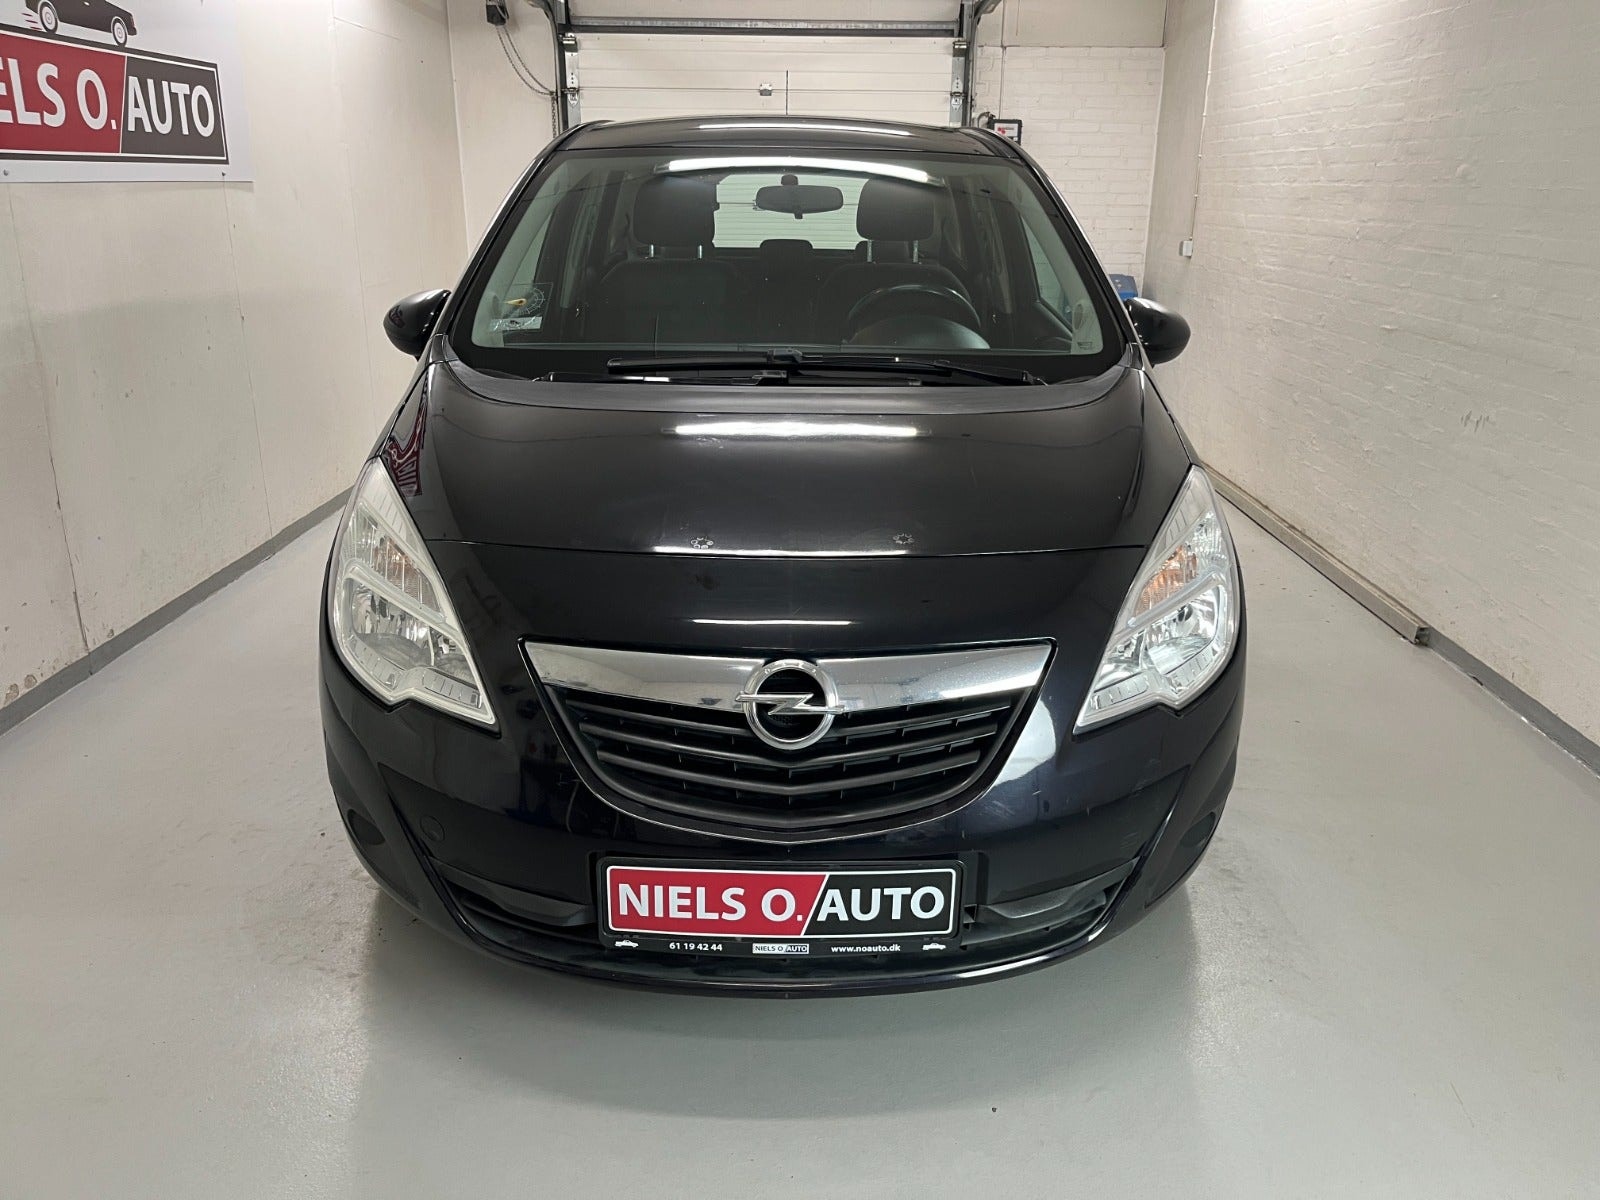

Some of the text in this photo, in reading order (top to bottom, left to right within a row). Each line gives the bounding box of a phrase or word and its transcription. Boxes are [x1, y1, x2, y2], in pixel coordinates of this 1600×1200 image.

[76, 68, 118, 130] O.
[127, 76, 215, 137] AUTO
[618, 883, 945, 923] NIELS O. AUTO
[669, 942, 723, 951] 61 19 42 44
[831, 944, 901, 953] www.noauto.dk
